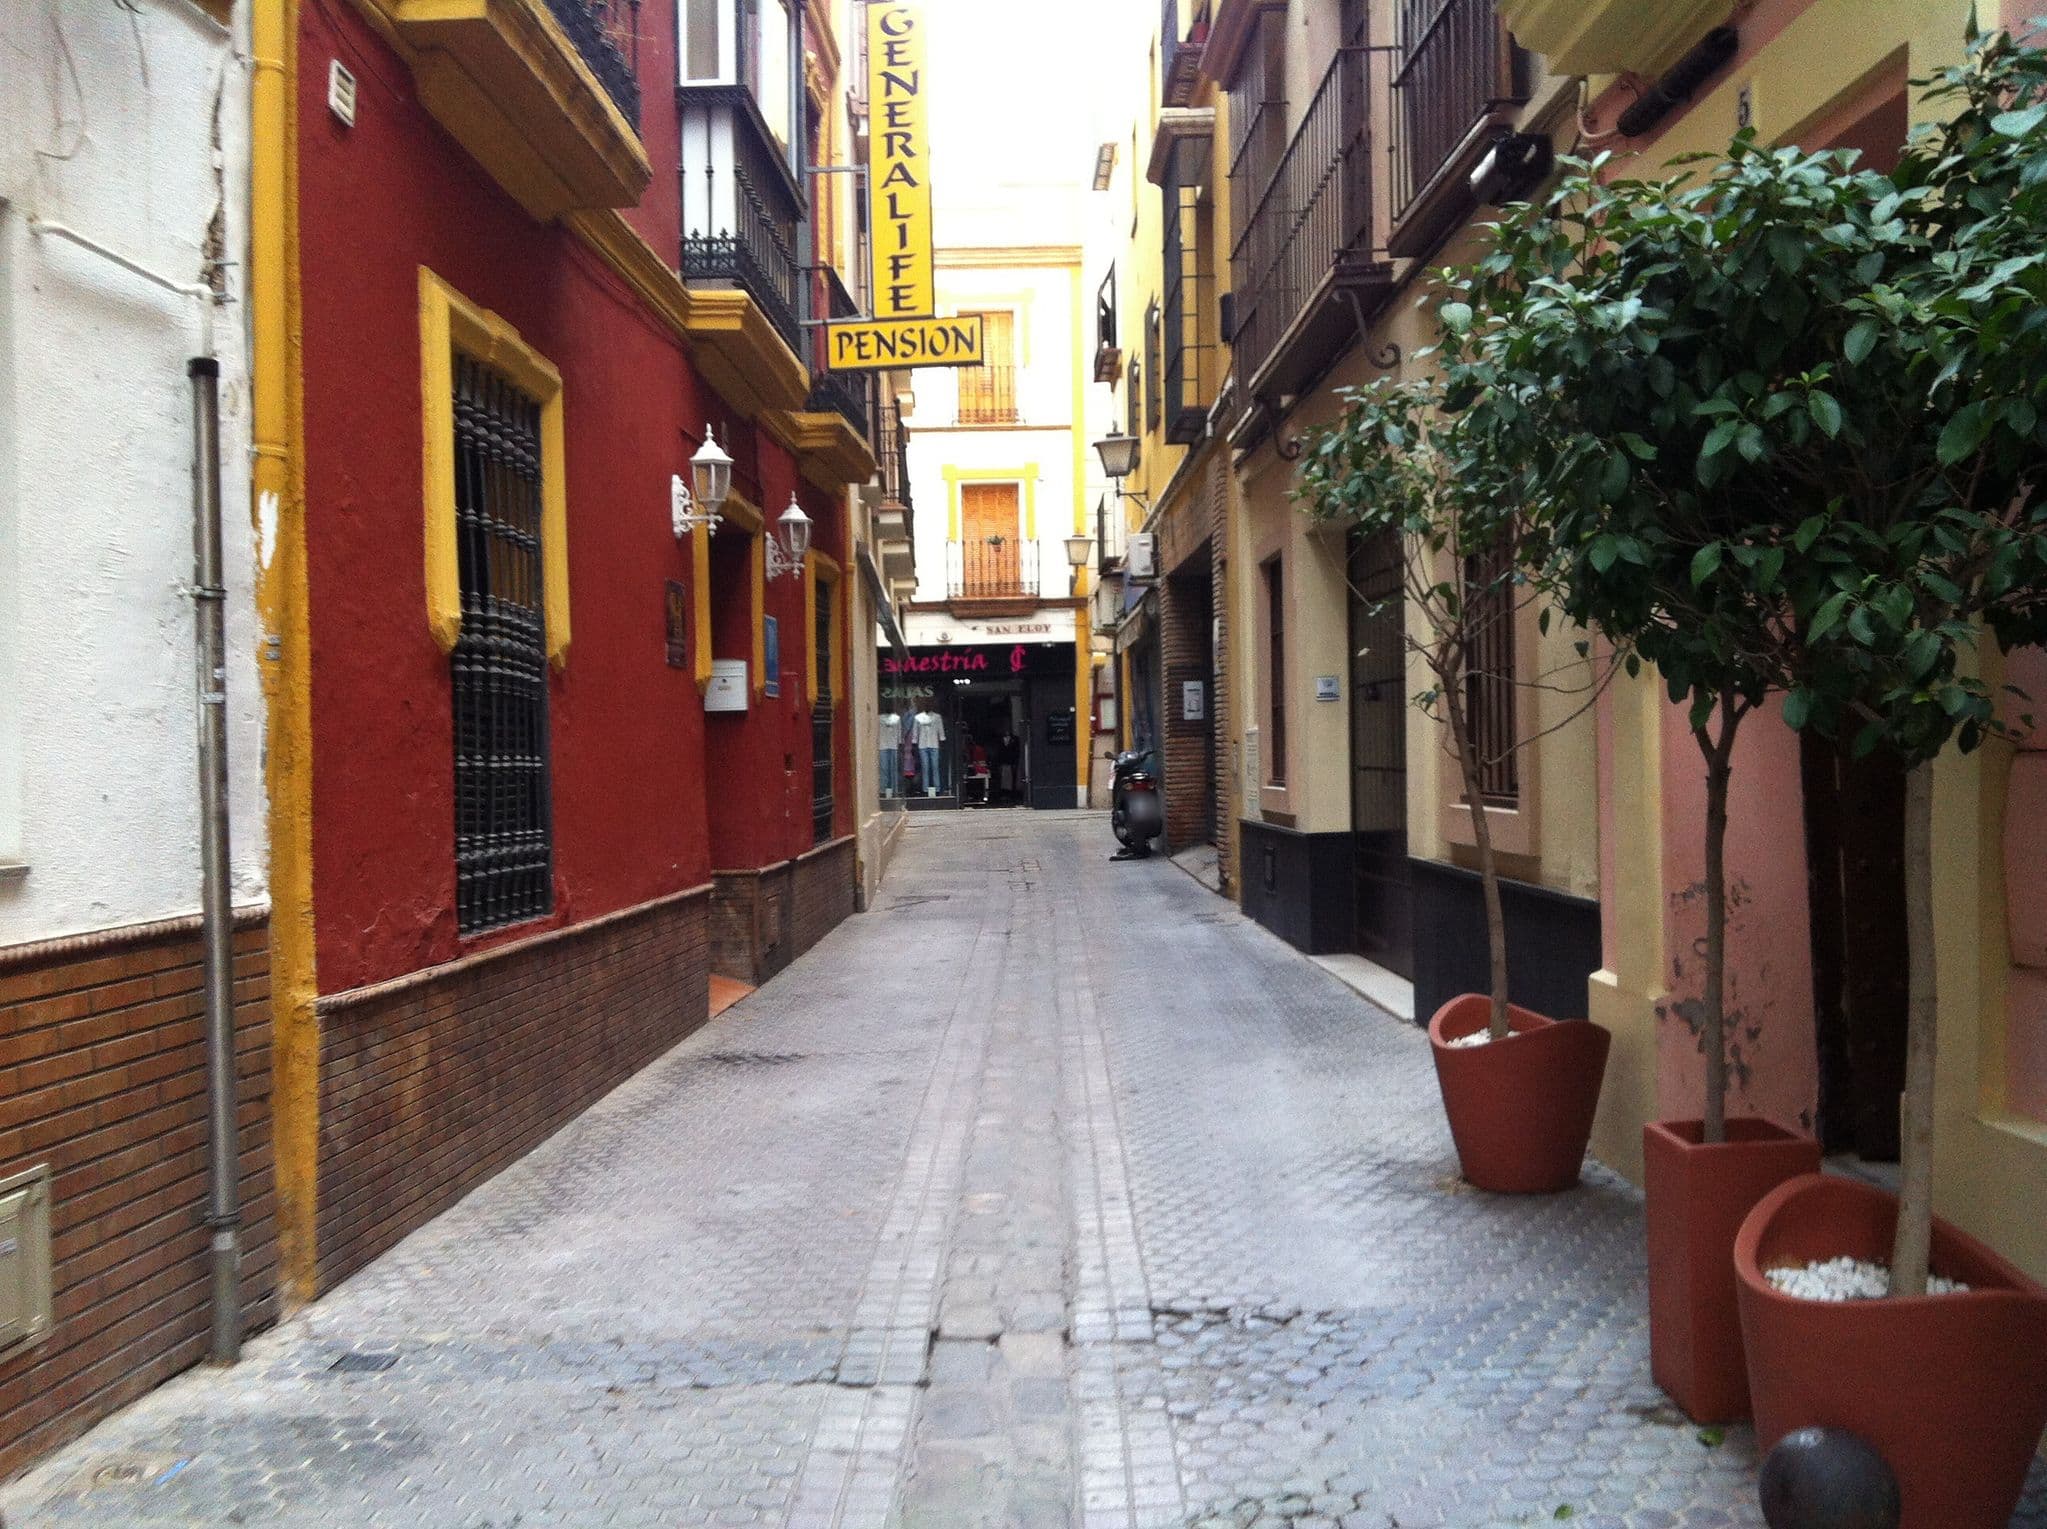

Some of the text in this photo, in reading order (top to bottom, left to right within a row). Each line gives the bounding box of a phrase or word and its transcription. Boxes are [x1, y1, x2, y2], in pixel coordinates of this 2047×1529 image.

[877, 9, 919, 313] GENERALIFE
[835, 324, 975, 361] PENSION
[986, 623, 1051, 635] SAN ELOY
